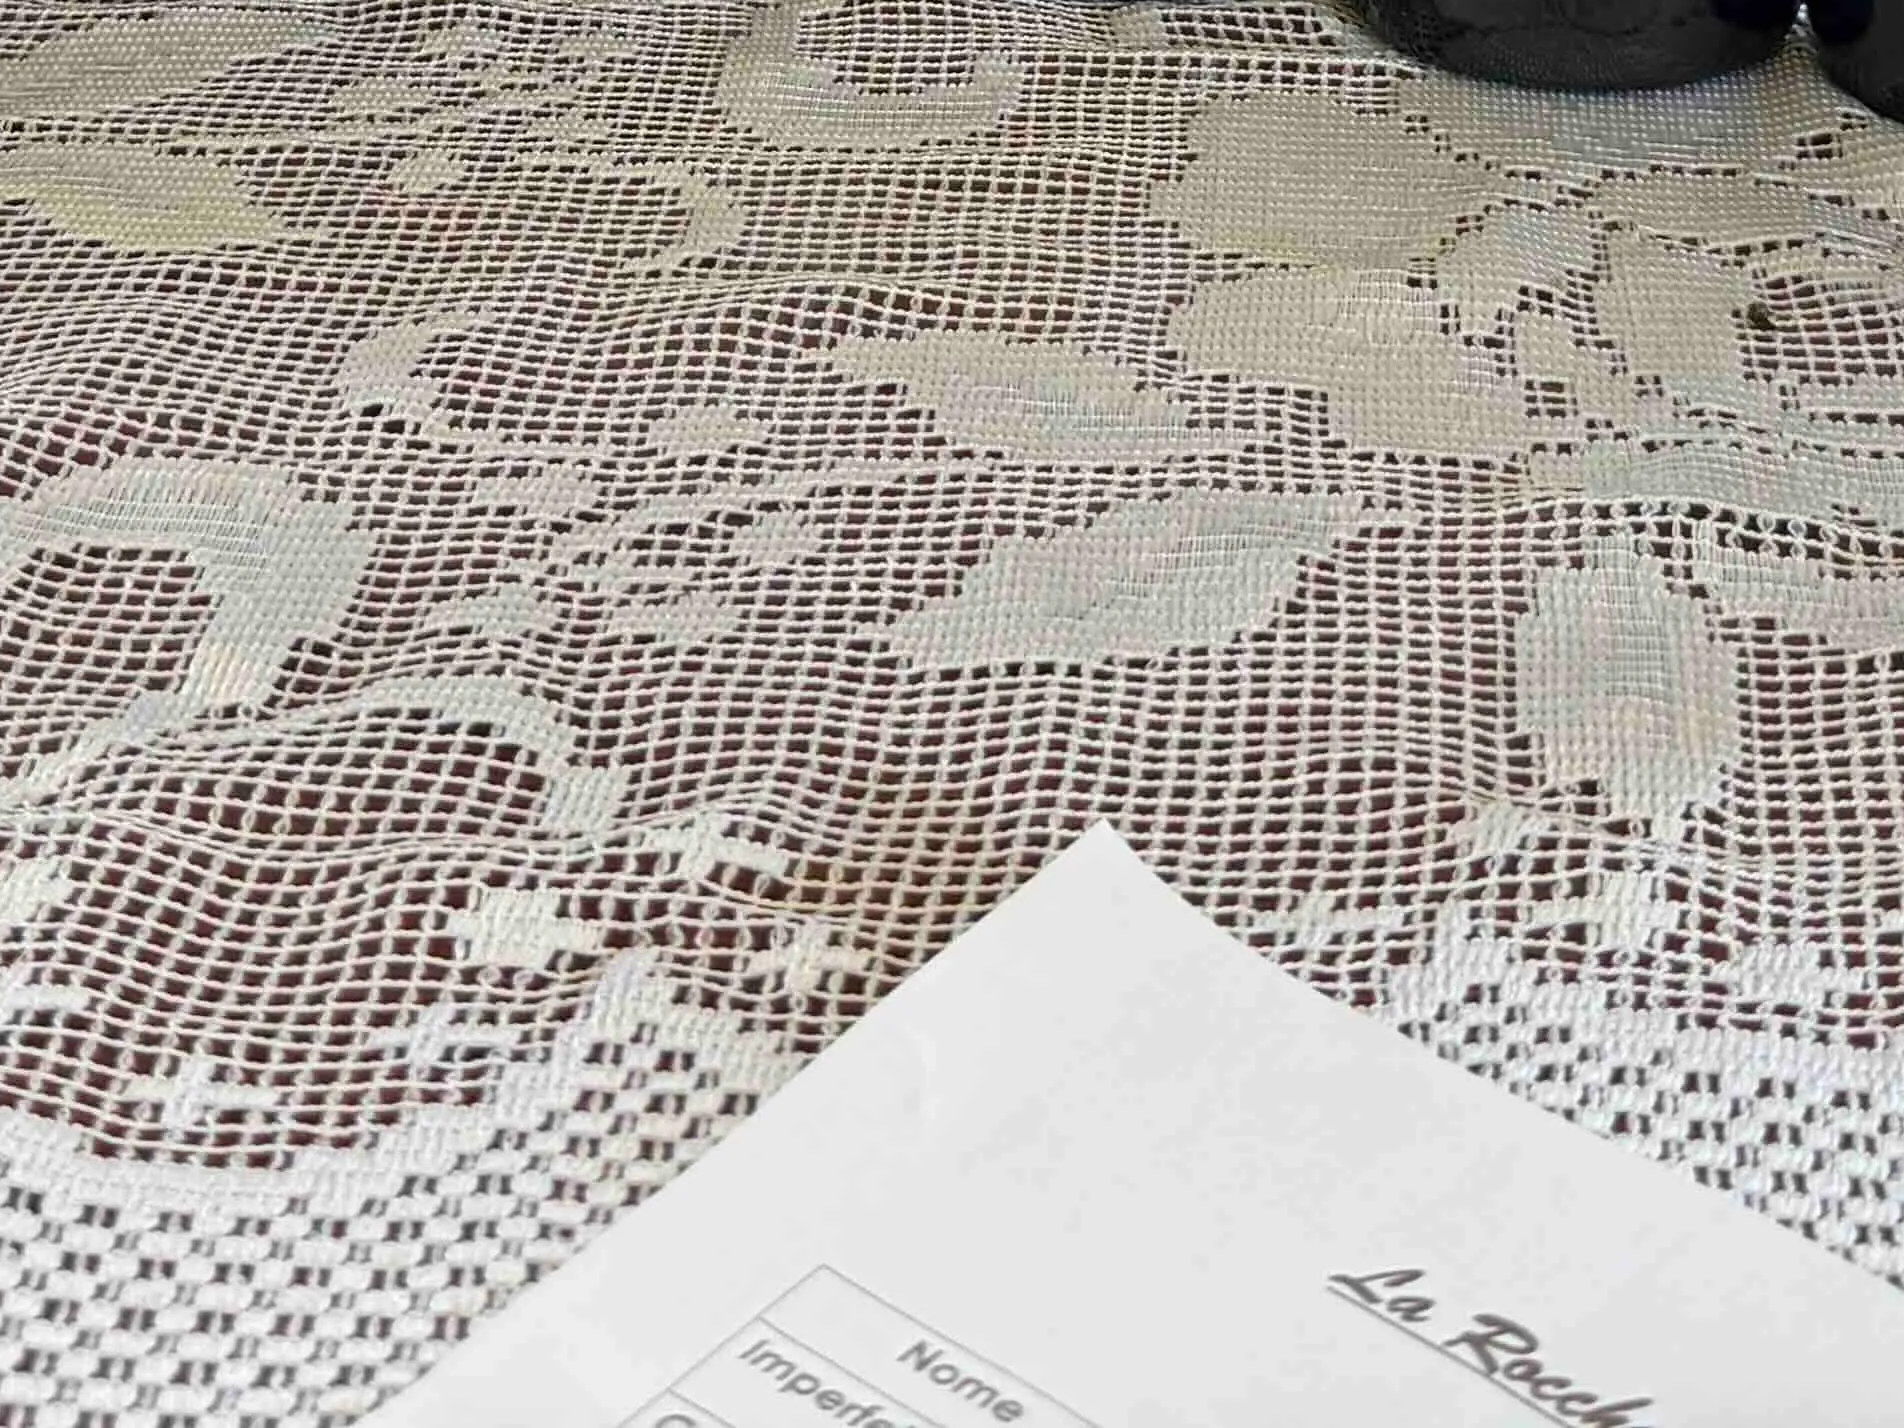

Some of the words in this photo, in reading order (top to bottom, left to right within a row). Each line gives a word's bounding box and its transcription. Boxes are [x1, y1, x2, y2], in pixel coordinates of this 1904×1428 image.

[896, 1338, 1026, 1425] Nome
[1327, 1268, 1437, 1323] La
[1442, 1312, 1654, 1428] Rocch
